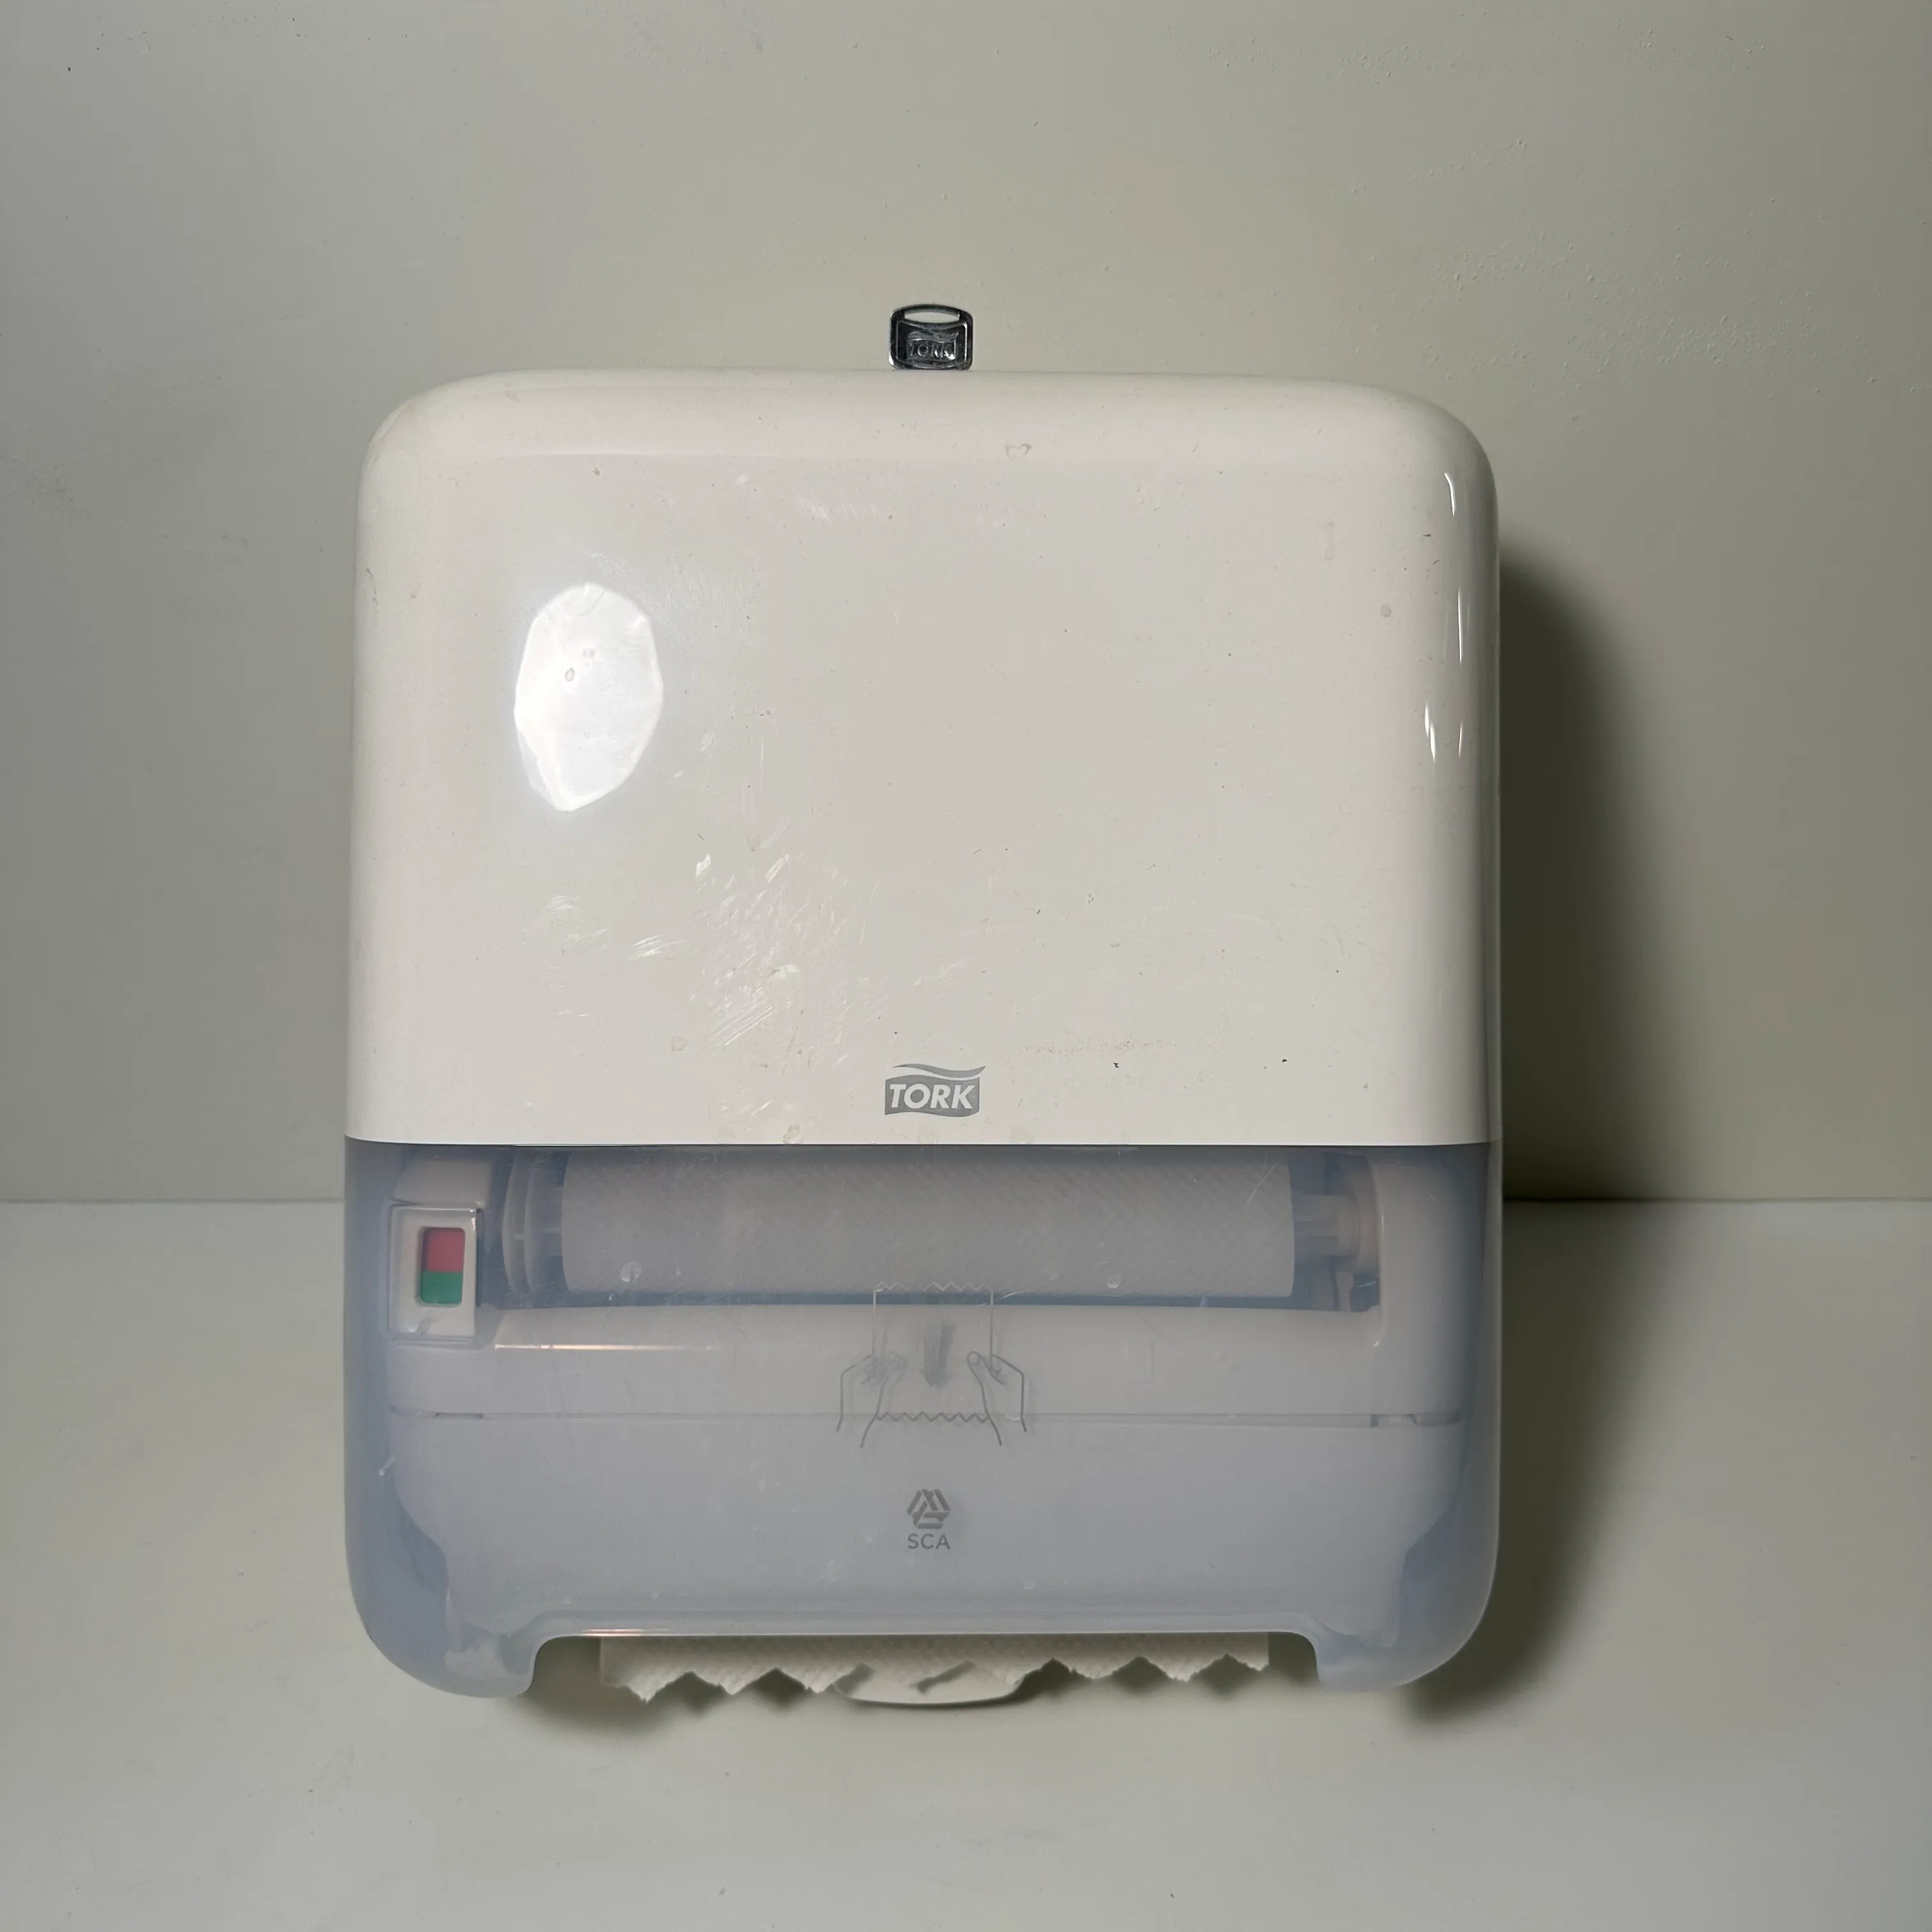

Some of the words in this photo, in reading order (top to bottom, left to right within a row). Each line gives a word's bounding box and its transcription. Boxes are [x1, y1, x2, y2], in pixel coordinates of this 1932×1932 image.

[909, 342, 954, 359] TORK
[889, 1083, 976, 1109] TORK
[907, 1533, 951, 1549] SCA
